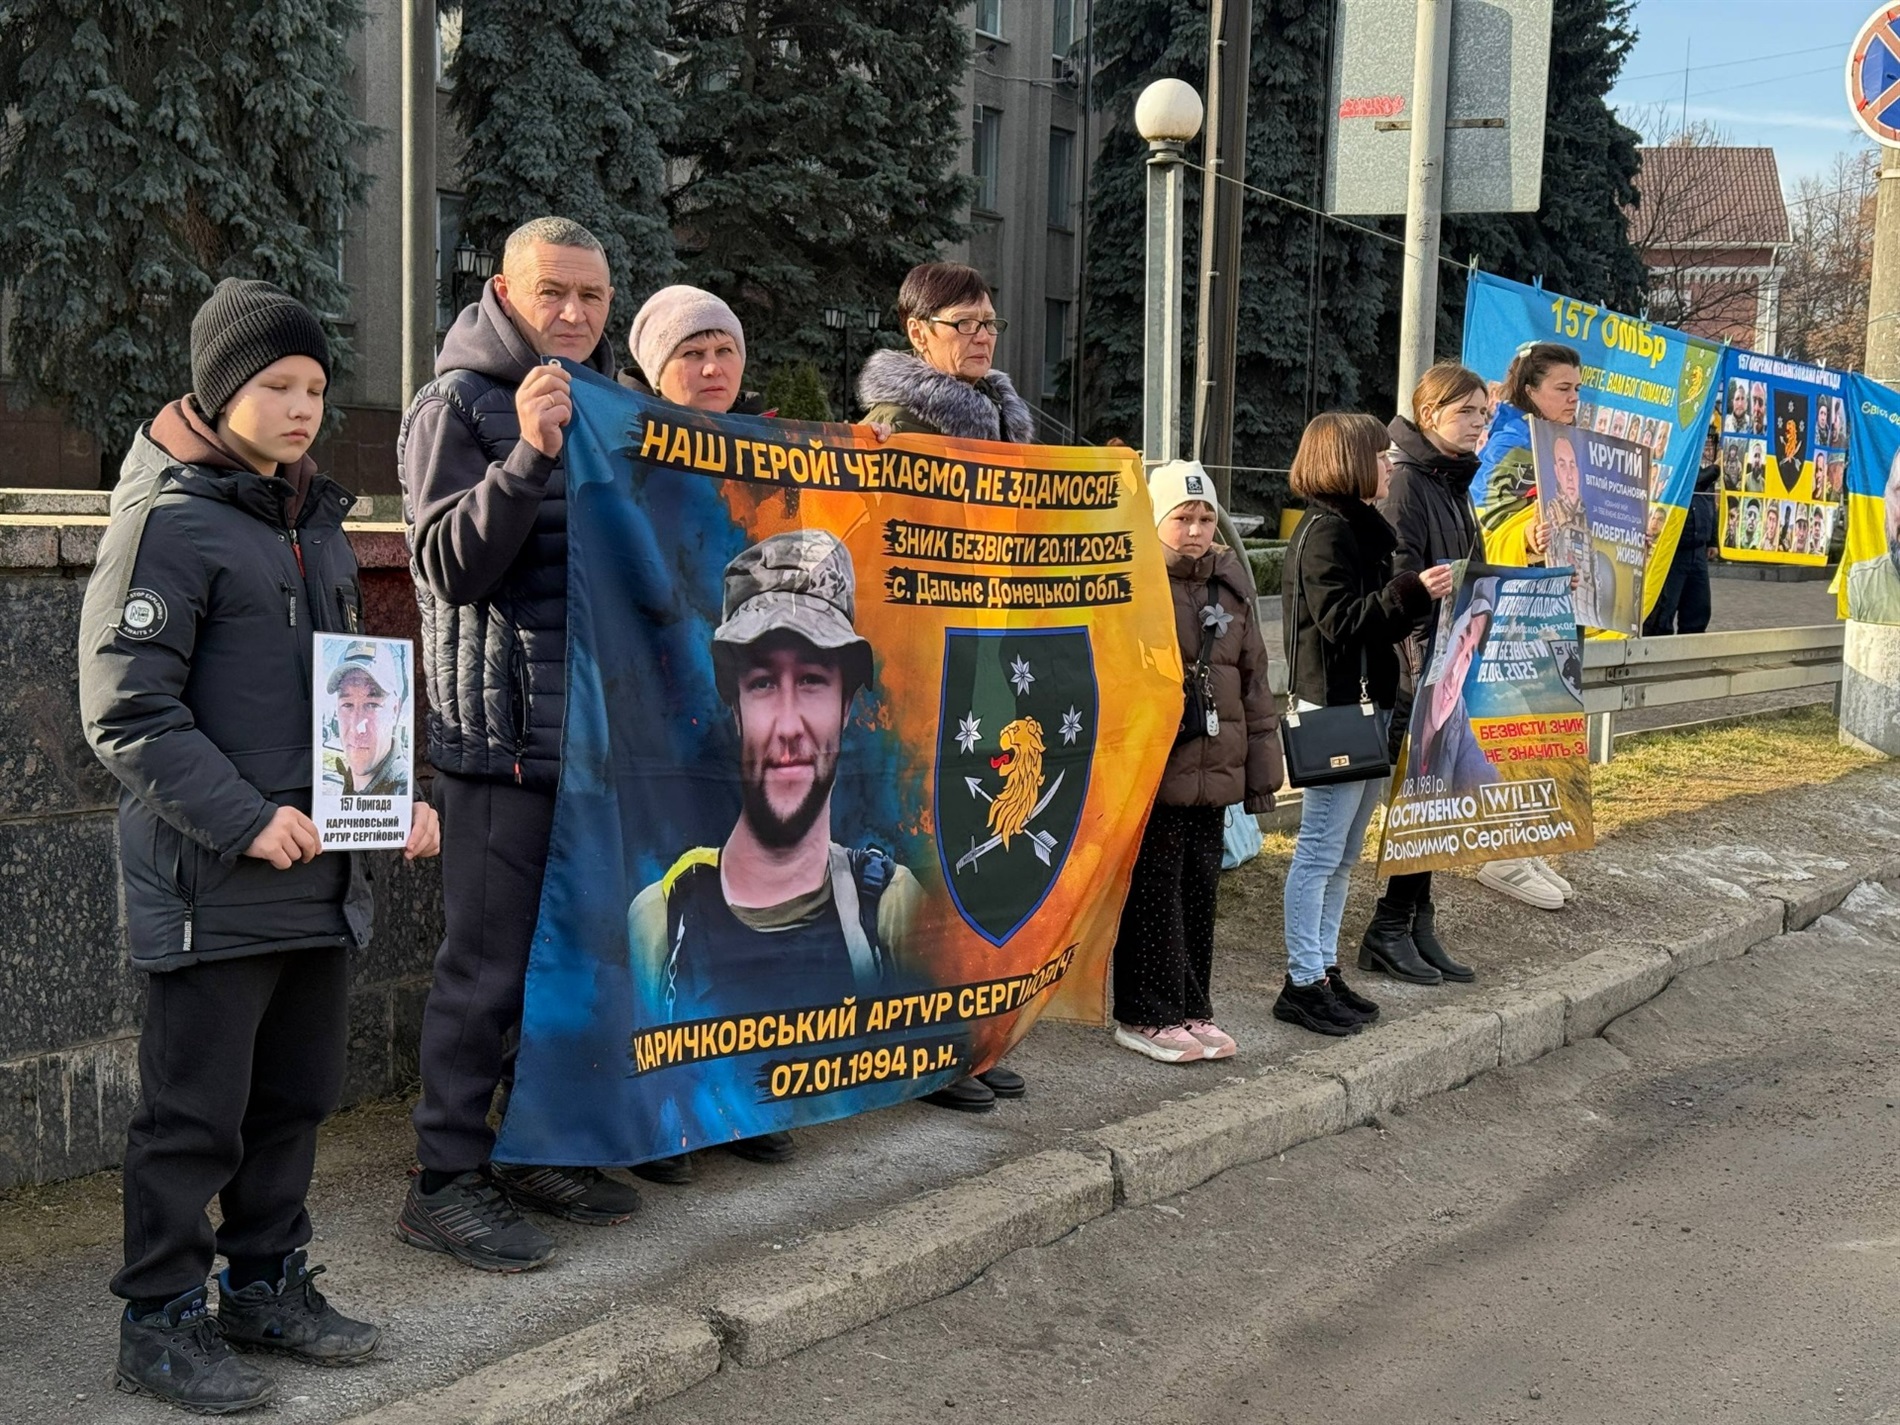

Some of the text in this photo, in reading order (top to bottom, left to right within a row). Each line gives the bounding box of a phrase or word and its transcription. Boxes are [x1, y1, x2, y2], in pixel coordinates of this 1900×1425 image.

[1552, 297, 1666, 369] 157 ОМБр
[1606, 372, 1626, 395] ВАМ
[1623, 376, 1640, 398] БОГ
[640, 420, 1115, 509] НАШ ГЕРОЙ! ЧЕКАЄМО, НЕ ЗДАМОСЯ!
[1588, 441, 1642, 478] КРУТИЙ
[894, 525, 1127, 563] ЗНИК БЕЗВІСТИ 20.11.2024
[916, 572, 984, 604] Дальнє
[987, 575, 1081, 608] Донецької
[1085, 574, 1125, 601] обл.
[1480, 718, 1584, 740] БЕЗВІСТИ ЗНИК
[1484, 747, 1505, 763] НЕ
[1507, 743, 1571, 761] ЗНАЧИТЬ
[340, 797, 392, 812] 157 бригада
[1485, 783, 1552, 812] WILLY
[323, 830, 404, 842] АРТУР СЕРГІЙОВИЧ
[326, 816, 399, 828] КАРІЧКОВСЬКИЙ
[1384, 820, 1576, 862] Володимир Сергійович
[634, 995, 857, 1072] КАРИЧКОВСЬКИЙ
[866, 992, 953, 1032] АРТУР
[771, 1045, 907, 1097] 07.01.1994
